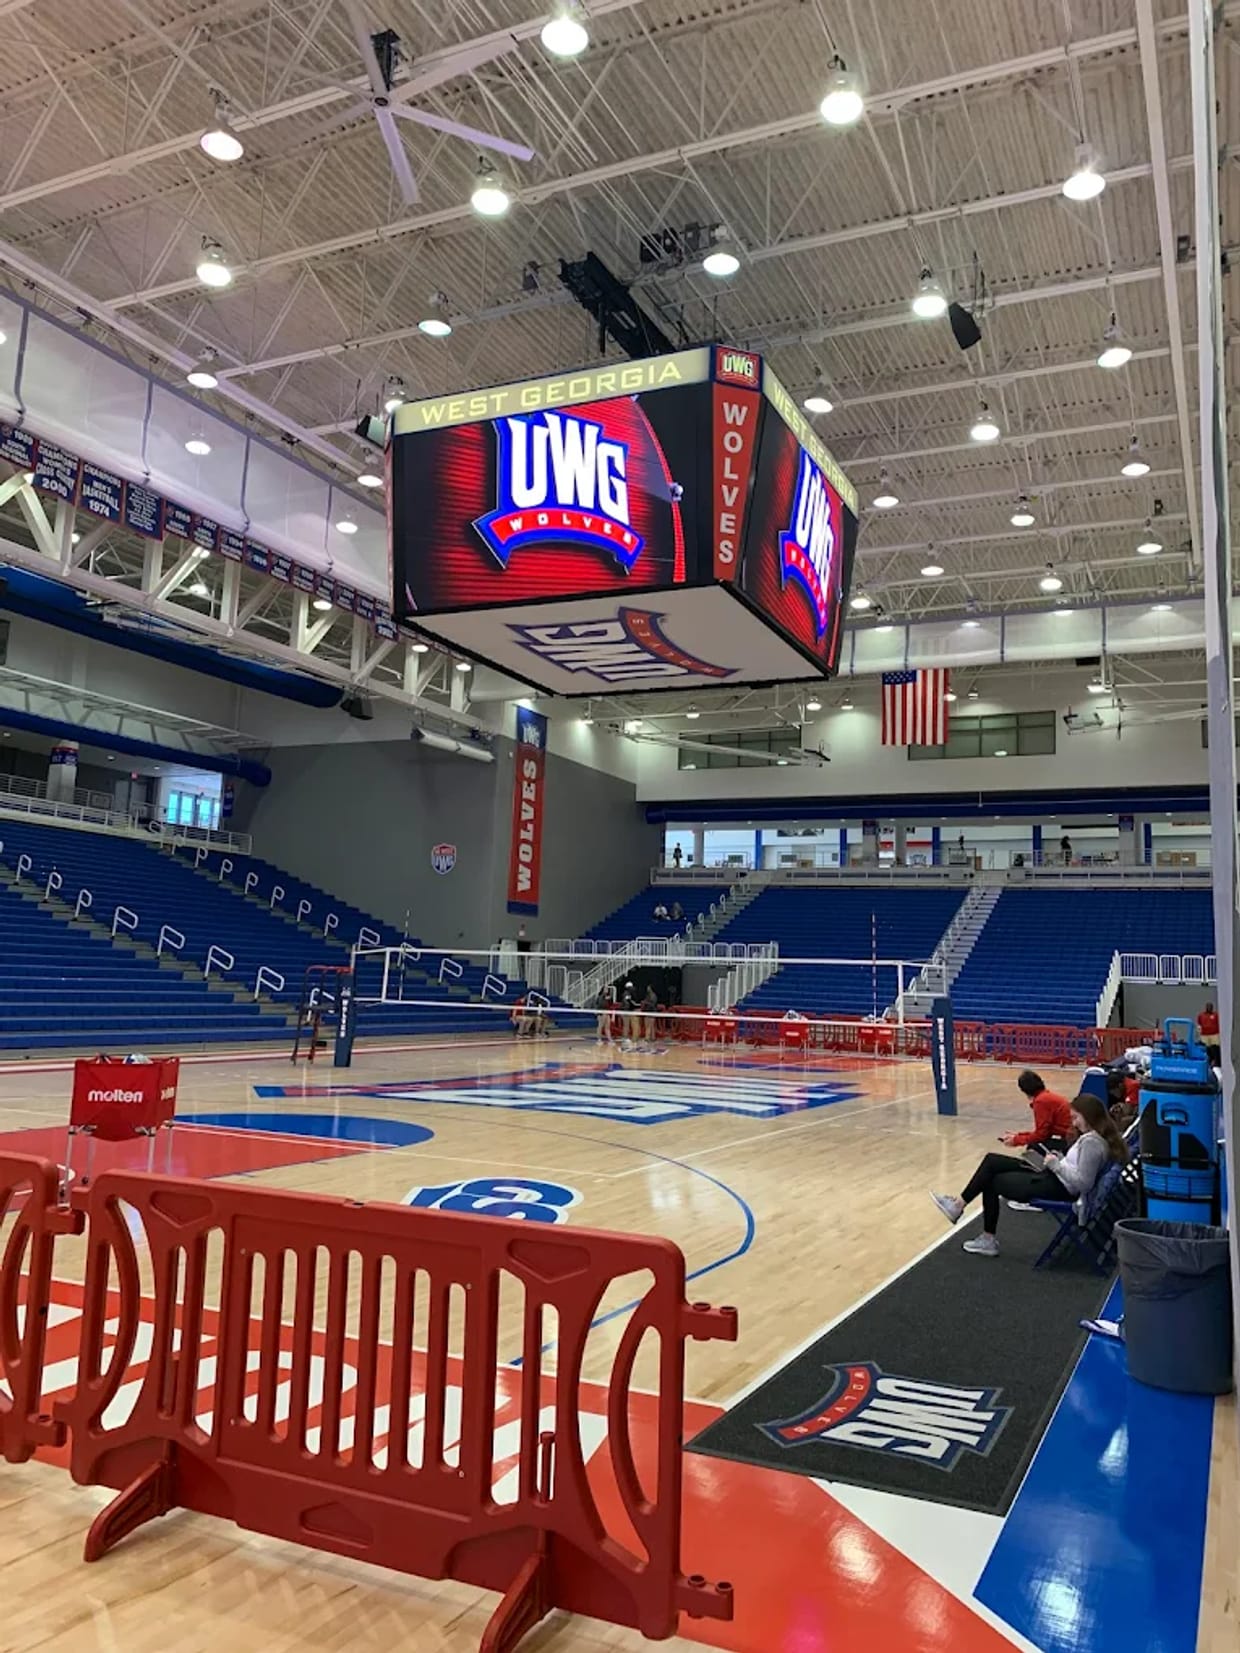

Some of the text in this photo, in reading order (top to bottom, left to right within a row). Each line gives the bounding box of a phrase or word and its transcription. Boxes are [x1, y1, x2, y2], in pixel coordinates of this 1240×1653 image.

[421, 360, 682, 425] WEST GEORGIA
[722, 354, 754, 378] UWG
[773, 382, 807, 442] WEST
[506, 411, 630, 526] UWG
[721, 402, 748, 564] WOLVES
[509, 513, 632, 544] WOLVES
[522, 620, 690, 681] UWG
[517, 758, 537, 893] WOLVES
[88, 1090, 143, 1102] molten
[793, 1370, 867, 1435] WOLVES
[821, 1377, 996, 1460] UWG
